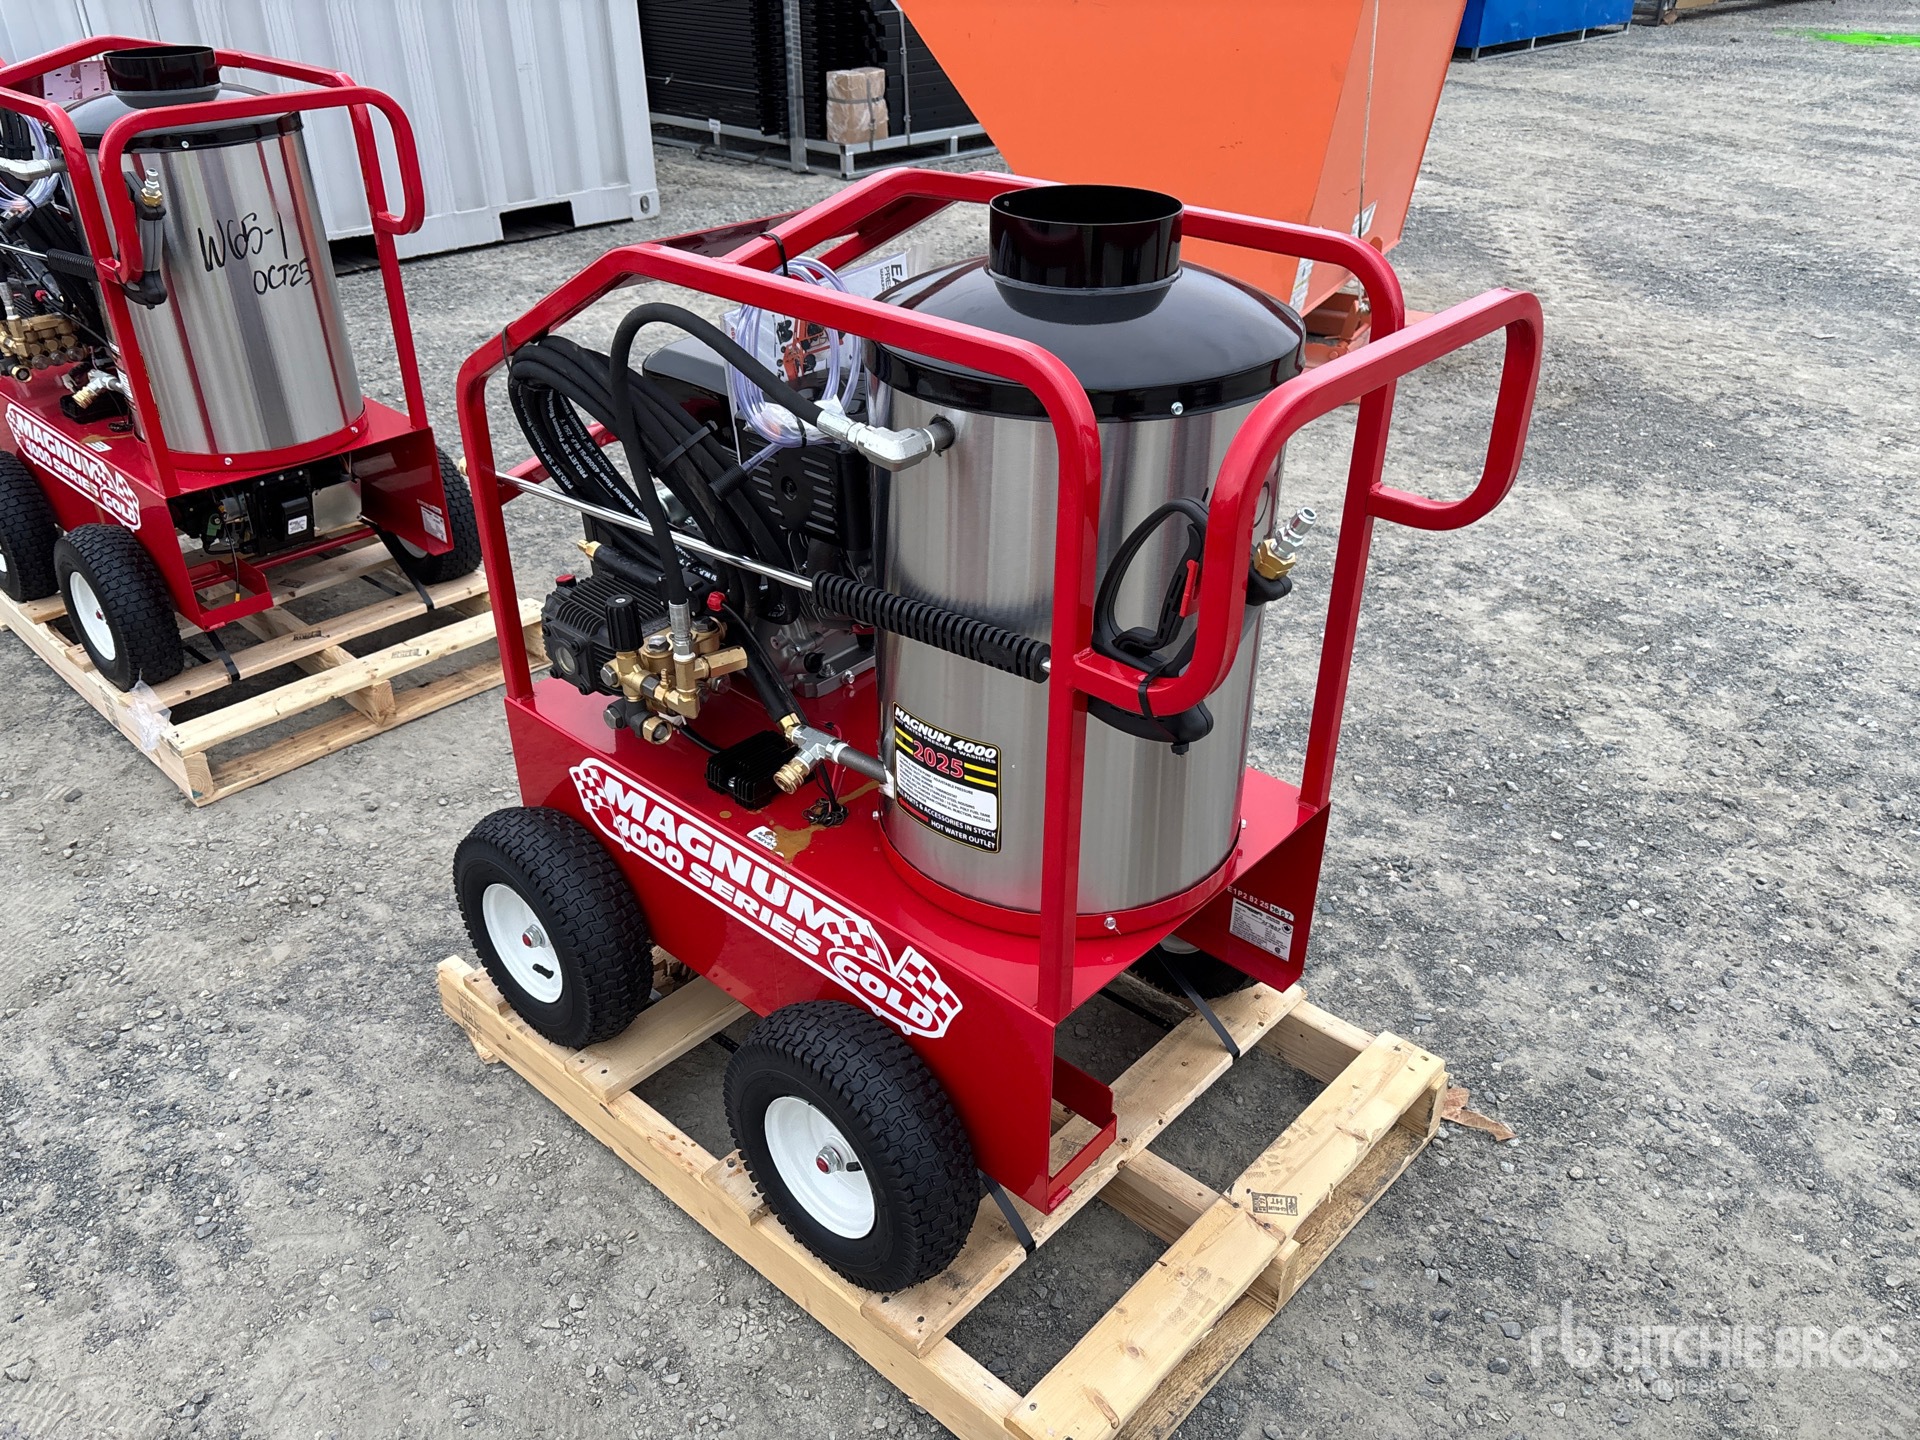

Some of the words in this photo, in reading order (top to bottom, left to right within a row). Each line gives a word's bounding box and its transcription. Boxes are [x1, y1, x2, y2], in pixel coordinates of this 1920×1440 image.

[15, 413, 101, 481] MAGNUM
[580, 448, 601, 473] 4500PSI
[25, 438, 53, 467] 4000
[54, 461, 100, 497] SERIES
[551, 465, 574, 490] PROJET
[568, 454, 588, 479] PROJET
[599, 472, 615, 489] Hose
[101, 492, 138, 524] GOLD
[613, 486, 635, 511] Washer
[895, 706, 952, 746] MAGNUM
[953, 740, 997, 759] 4000
[923, 736, 957, 753] PRESSURE
[958, 750, 996, 764] WASHERS
[913, 740, 964, 779] 2025
[904, 794, 919, 807] PARTS
[924, 806, 963, 829] ACCESSORIES
[964, 824, 972, 832] IN
[973, 826, 996, 838] STOCK
[931, 819, 944, 831] HOT
[944, 826, 968, 841] WATER
[968, 835, 996, 849] OUTLET
[603, 775, 846, 933] MAGNUM
[613, 814, 684, 872] 4000
[689, 862, 822, 956] SERIES
[833, 955, 933, 1028] GOLD
